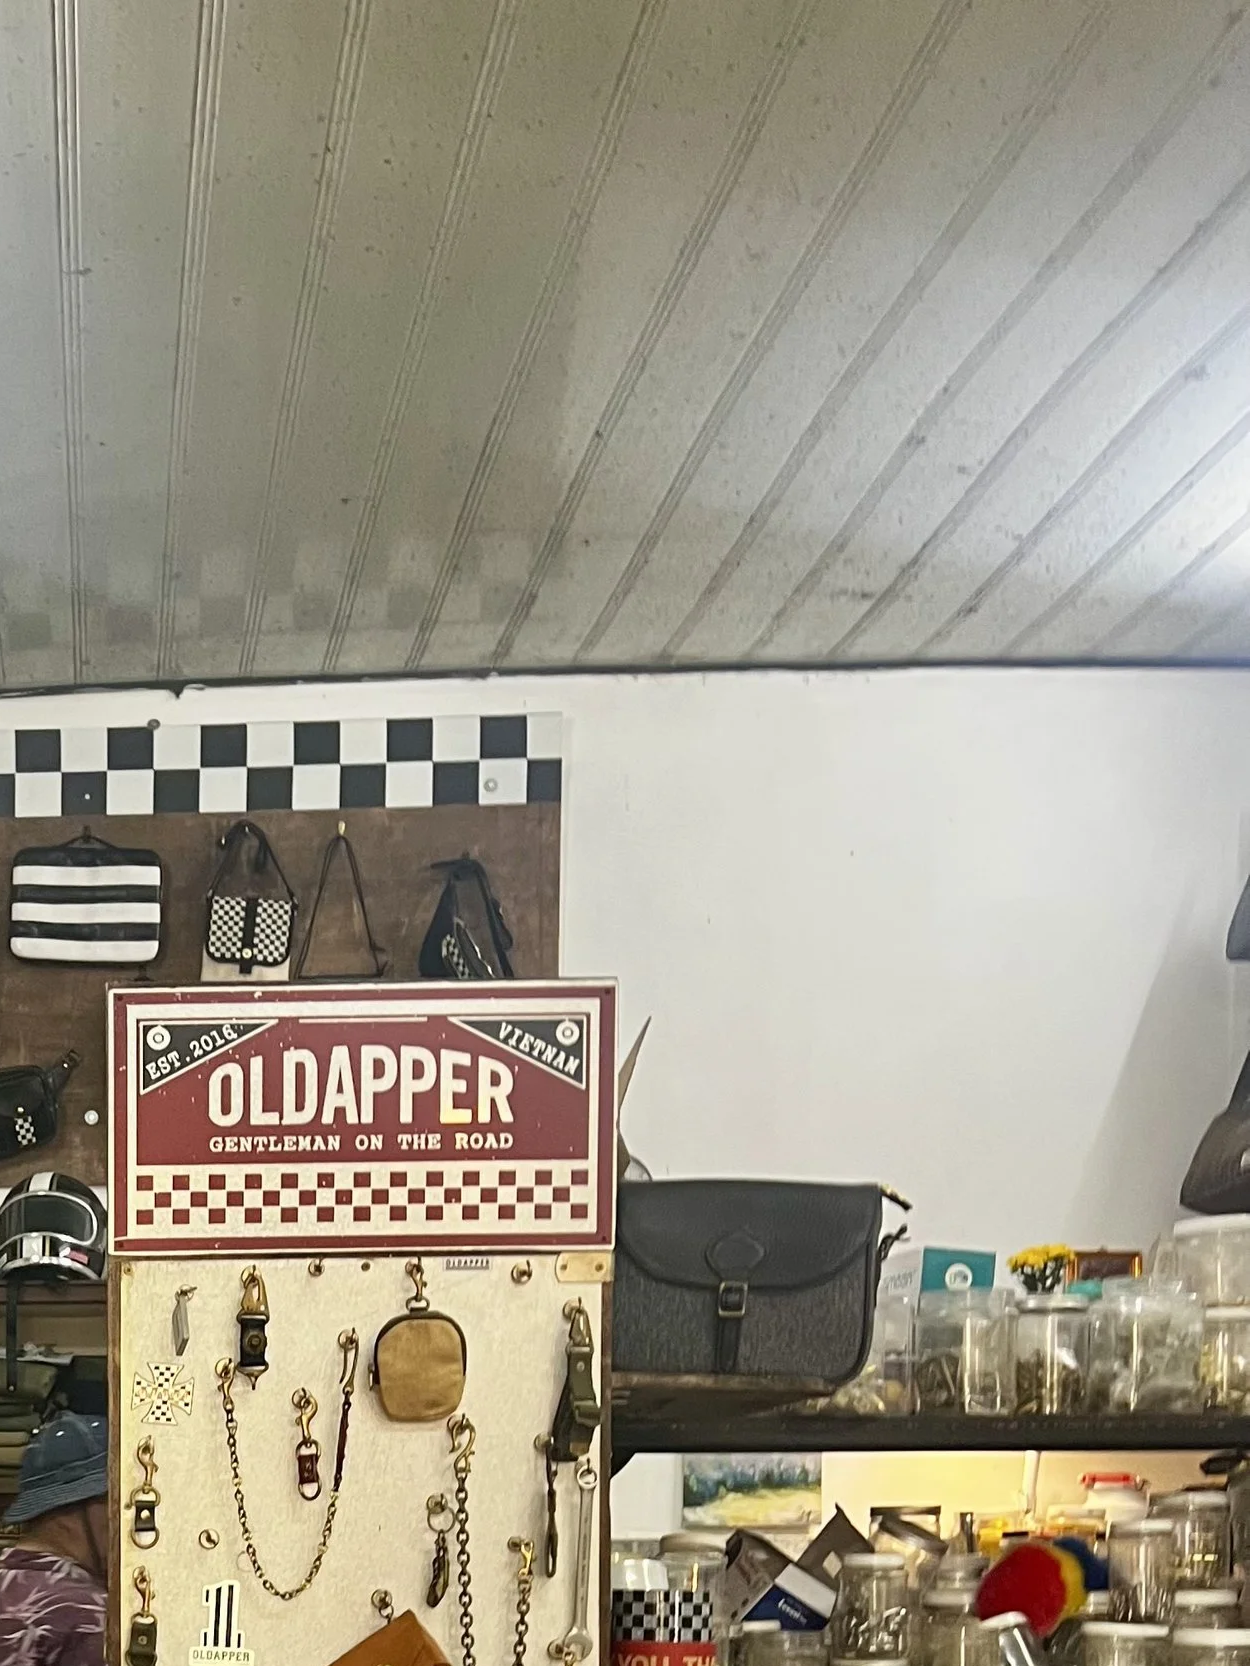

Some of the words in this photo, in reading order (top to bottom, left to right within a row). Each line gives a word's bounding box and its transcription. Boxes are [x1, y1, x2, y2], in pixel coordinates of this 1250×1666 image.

[207, 1044, 515, 1127] OLDAPPER
[208, 1134, 342, 1153] GENTLEMAN
[354, 1133, 384, 1151] ON
[397, 1132, 442, 1150] THE
[454, 1131, 515, 1150] ROAD
